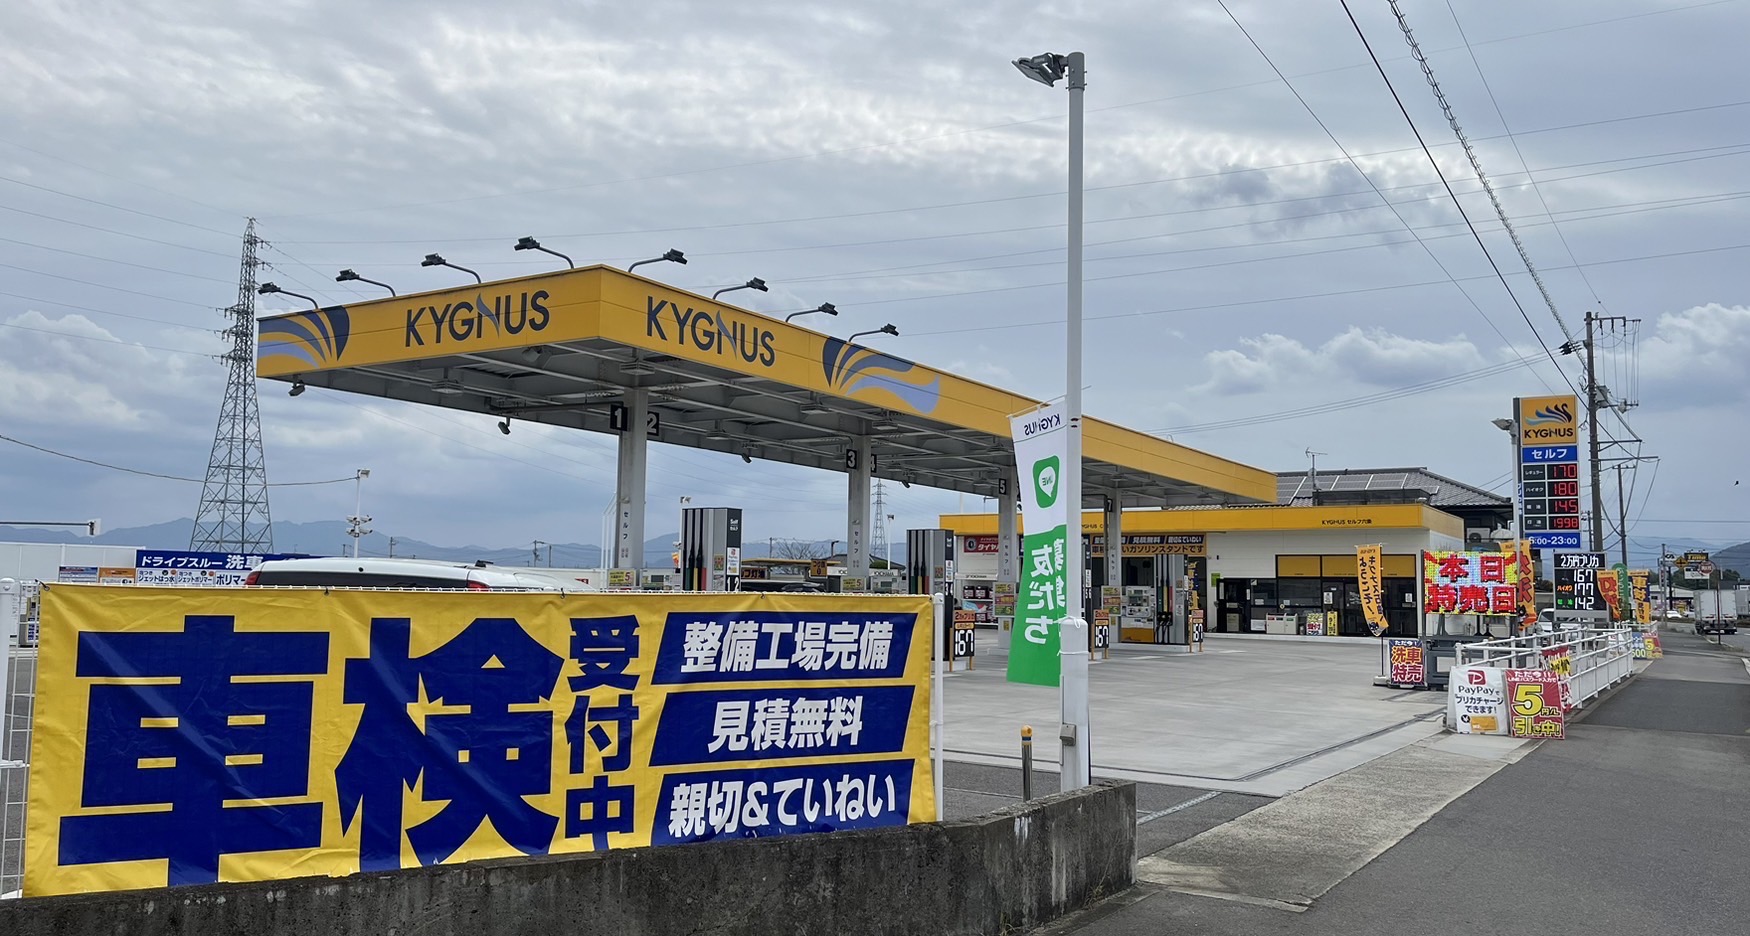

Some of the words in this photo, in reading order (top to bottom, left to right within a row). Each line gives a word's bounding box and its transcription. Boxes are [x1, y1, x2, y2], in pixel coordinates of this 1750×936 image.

[405, 290, 550, 347] KYGNUS
[646, 296, 776, 368] KYGNUS
[614, 408, 622, 428] 1
[646, 415, 657, 434] 2
[1523, 428, 1574, 439] KYGNUS
[847, 452, 856, 468] 3
[1531, 449, 1568, 460] セルフ
[1553, 465, 1577, 478] 170
[999, 480, 1006, 494] 5
[1554, 482, 1577, 496] 180
[1554, 500, 1578, 513] 145
[622, 511, 630, 540] セルフ
[1553, 518, 1579, 528] 1998
[141, 555, 223, 568] ドライブスルー
[225, 554, 263, 570] 洗車
[1439, 553, 1505, 583] 本日
[1573, 569, 1593, 582] 167
[1556, 584, 1573, 592] ハイオク
[1574, 582, 1594, 596] 177
[1424, 584, 1518, 614] 特売日
[1574, 596, 1595, 610] 142
[955, 629, 974, 656] 167
[1095, 625, 1109, 647] 167
[680, 620, 894, 673] 整備工場完備
[1391, 646, 1422, 665] 洗車
[1391, 664, 1423, 682] 特売
[1455, 694, 1504, 705] プリカチャージ
[1511, 683, 1544, 717] 5
[564, 614, 642, 852] 受付中
[707, 695, 864, 753] 見積無料
[58, 614, 565, 887] 車検
[668, 774, 896, 838] 親切&ていねい
